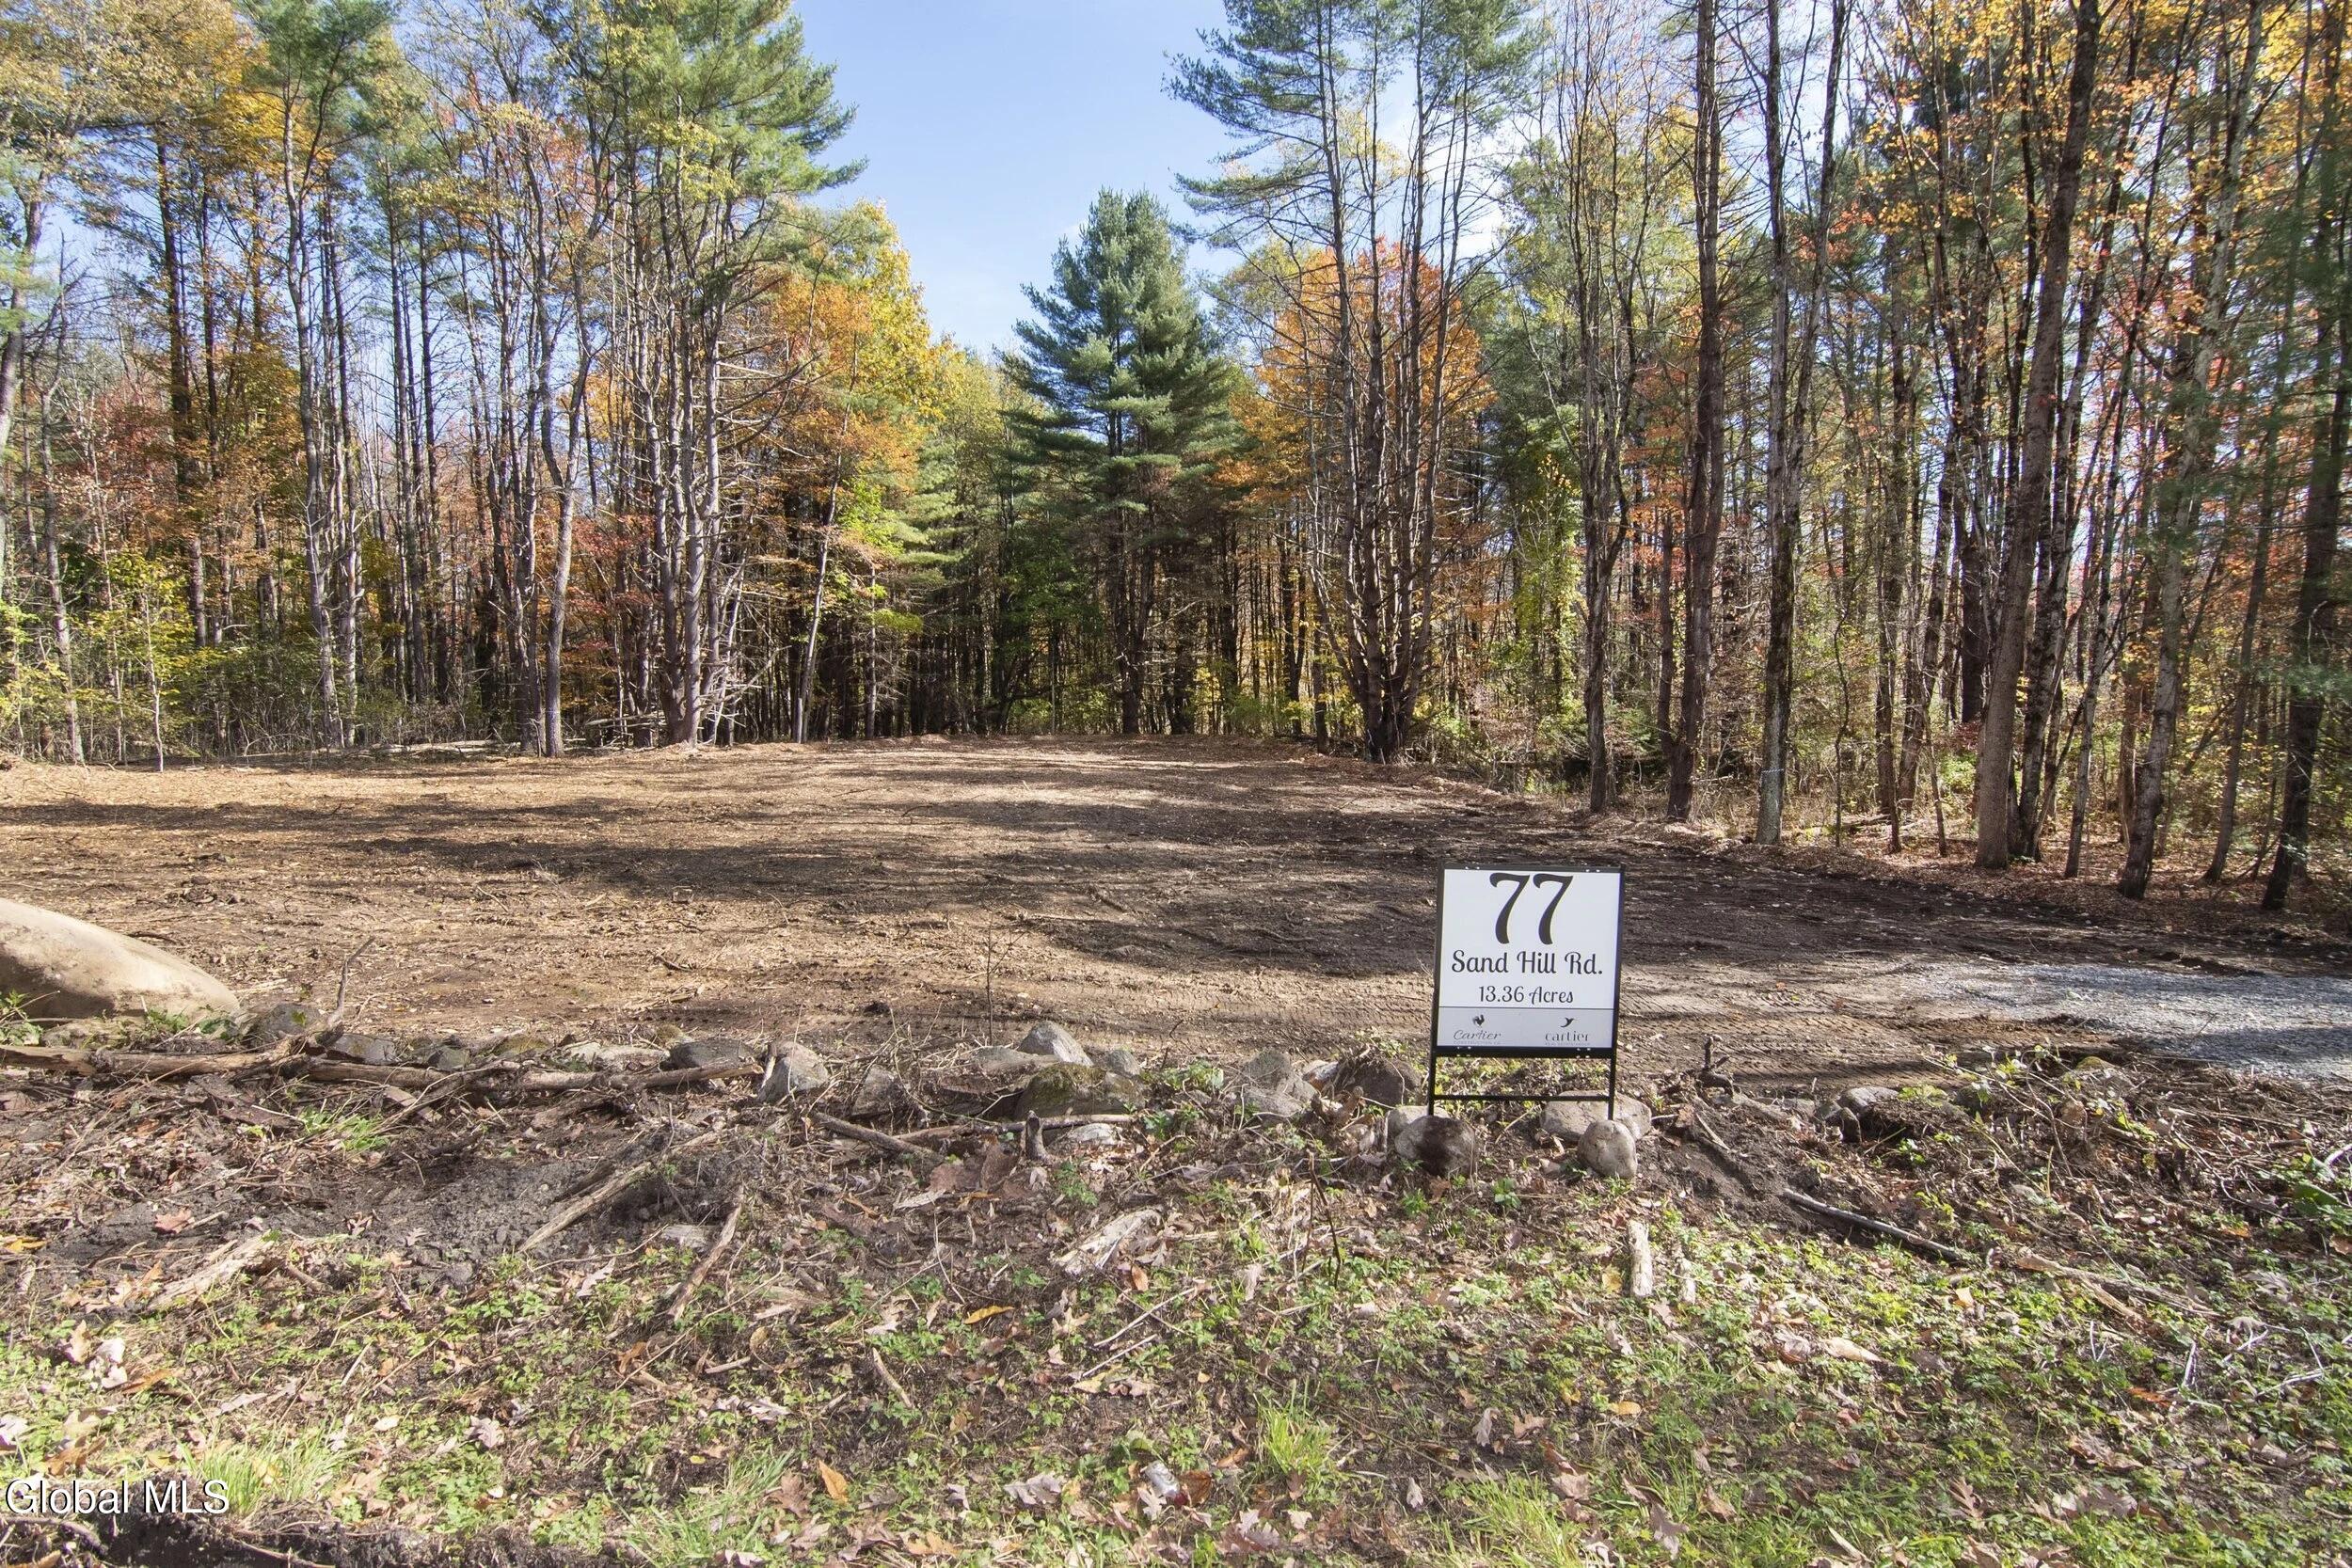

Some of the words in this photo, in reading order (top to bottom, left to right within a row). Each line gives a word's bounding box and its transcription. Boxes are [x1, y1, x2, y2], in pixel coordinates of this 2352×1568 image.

[1489, 872, 1574, 945] 77
[1452, 949, 1509, 974] Sand
[1517, 951, 1557, 974] Hill
[1565, 951, 1603, 975] Rd.
[1478, 985, 1525, 1003] 13.36
[1529, 986, 1574, 1006] Acres
[1453, 1029, 1502, 1041] Cartier
